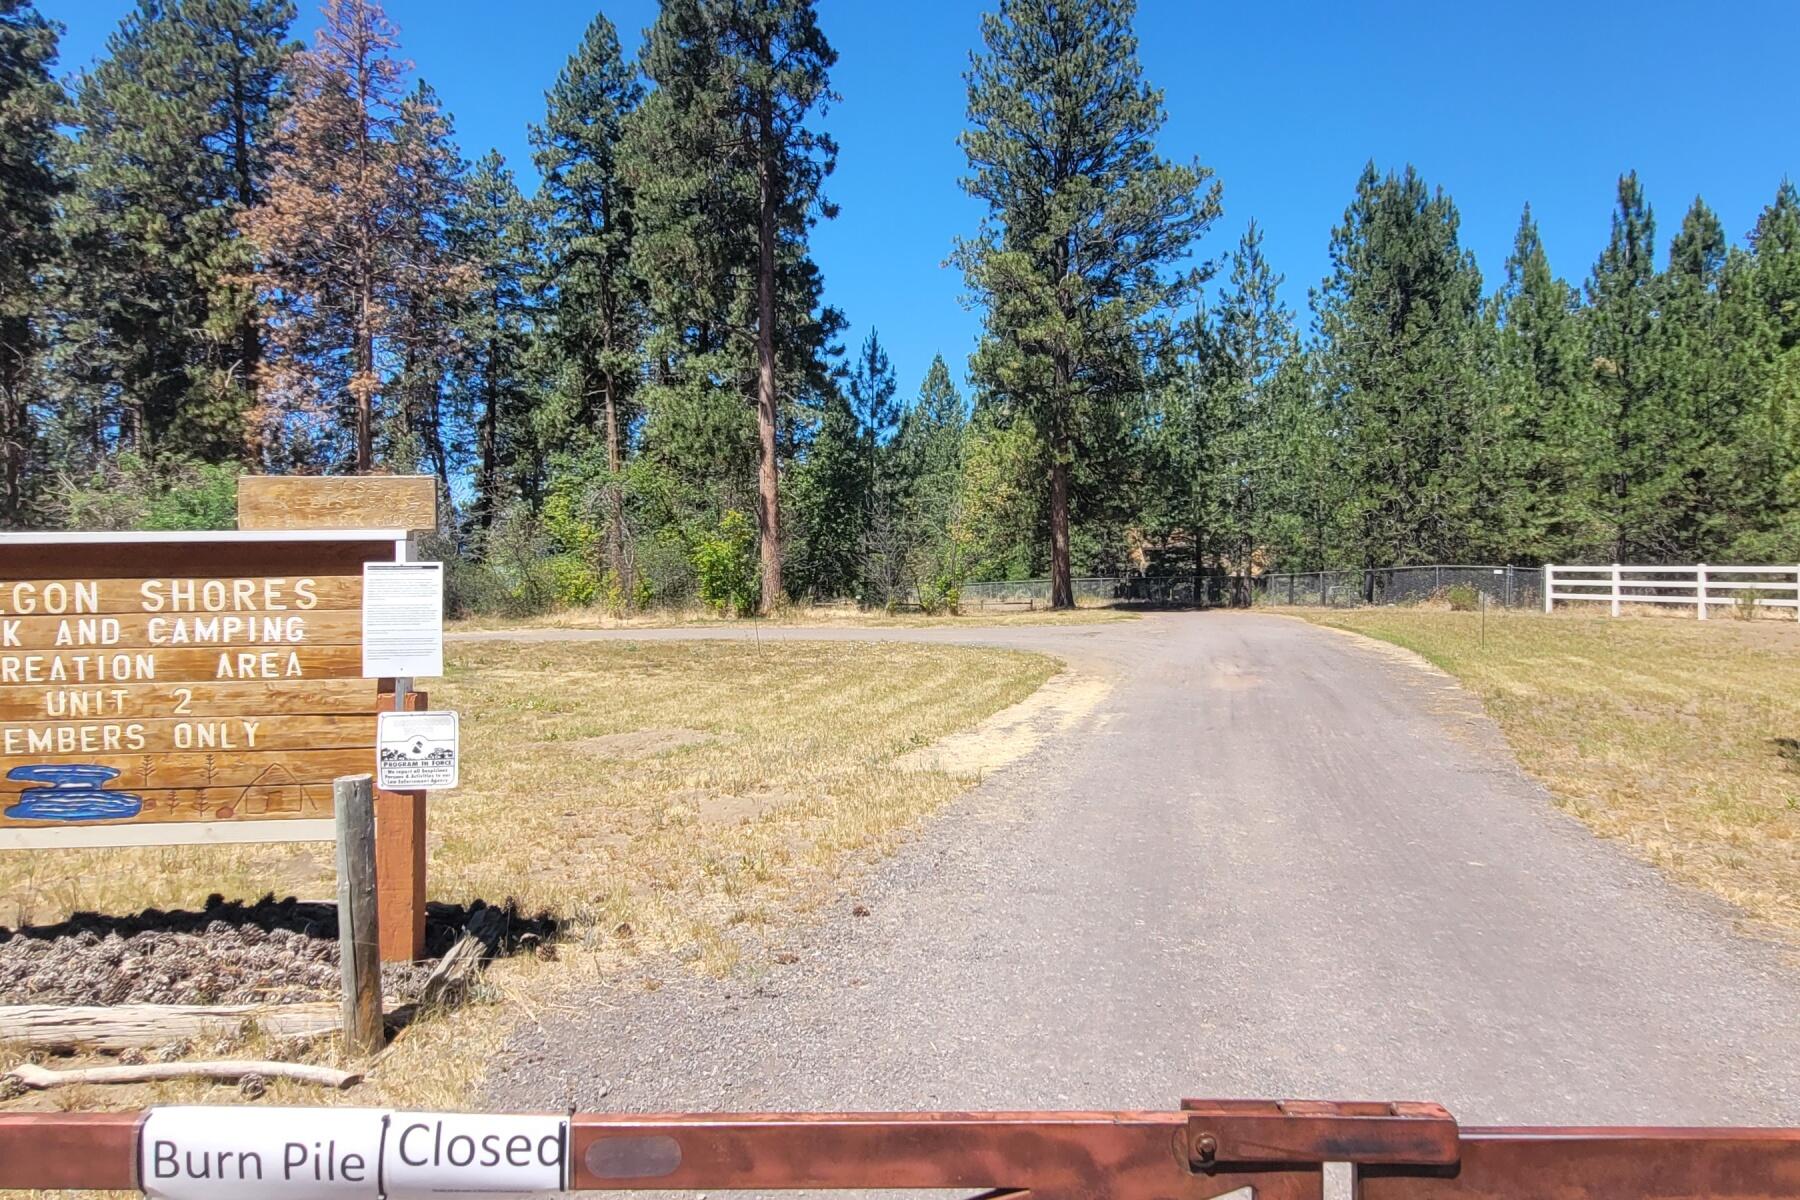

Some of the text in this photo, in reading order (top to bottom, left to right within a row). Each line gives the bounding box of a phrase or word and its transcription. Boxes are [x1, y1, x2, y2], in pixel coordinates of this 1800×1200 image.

[0, 579, 318, 615] GON SHORES
[55, 618, 120, 647] AND
[148, 616, 304, 645] CAMPING
[216, 652, 303, 679] AREA
[46, 688, 193, 717] UNIT 2
[5, 721, 260, 754] EMBERS ONLY
[399, 1120, 562, 1167] Closed
[154, 1140, 365, 1182] Burn Pile
